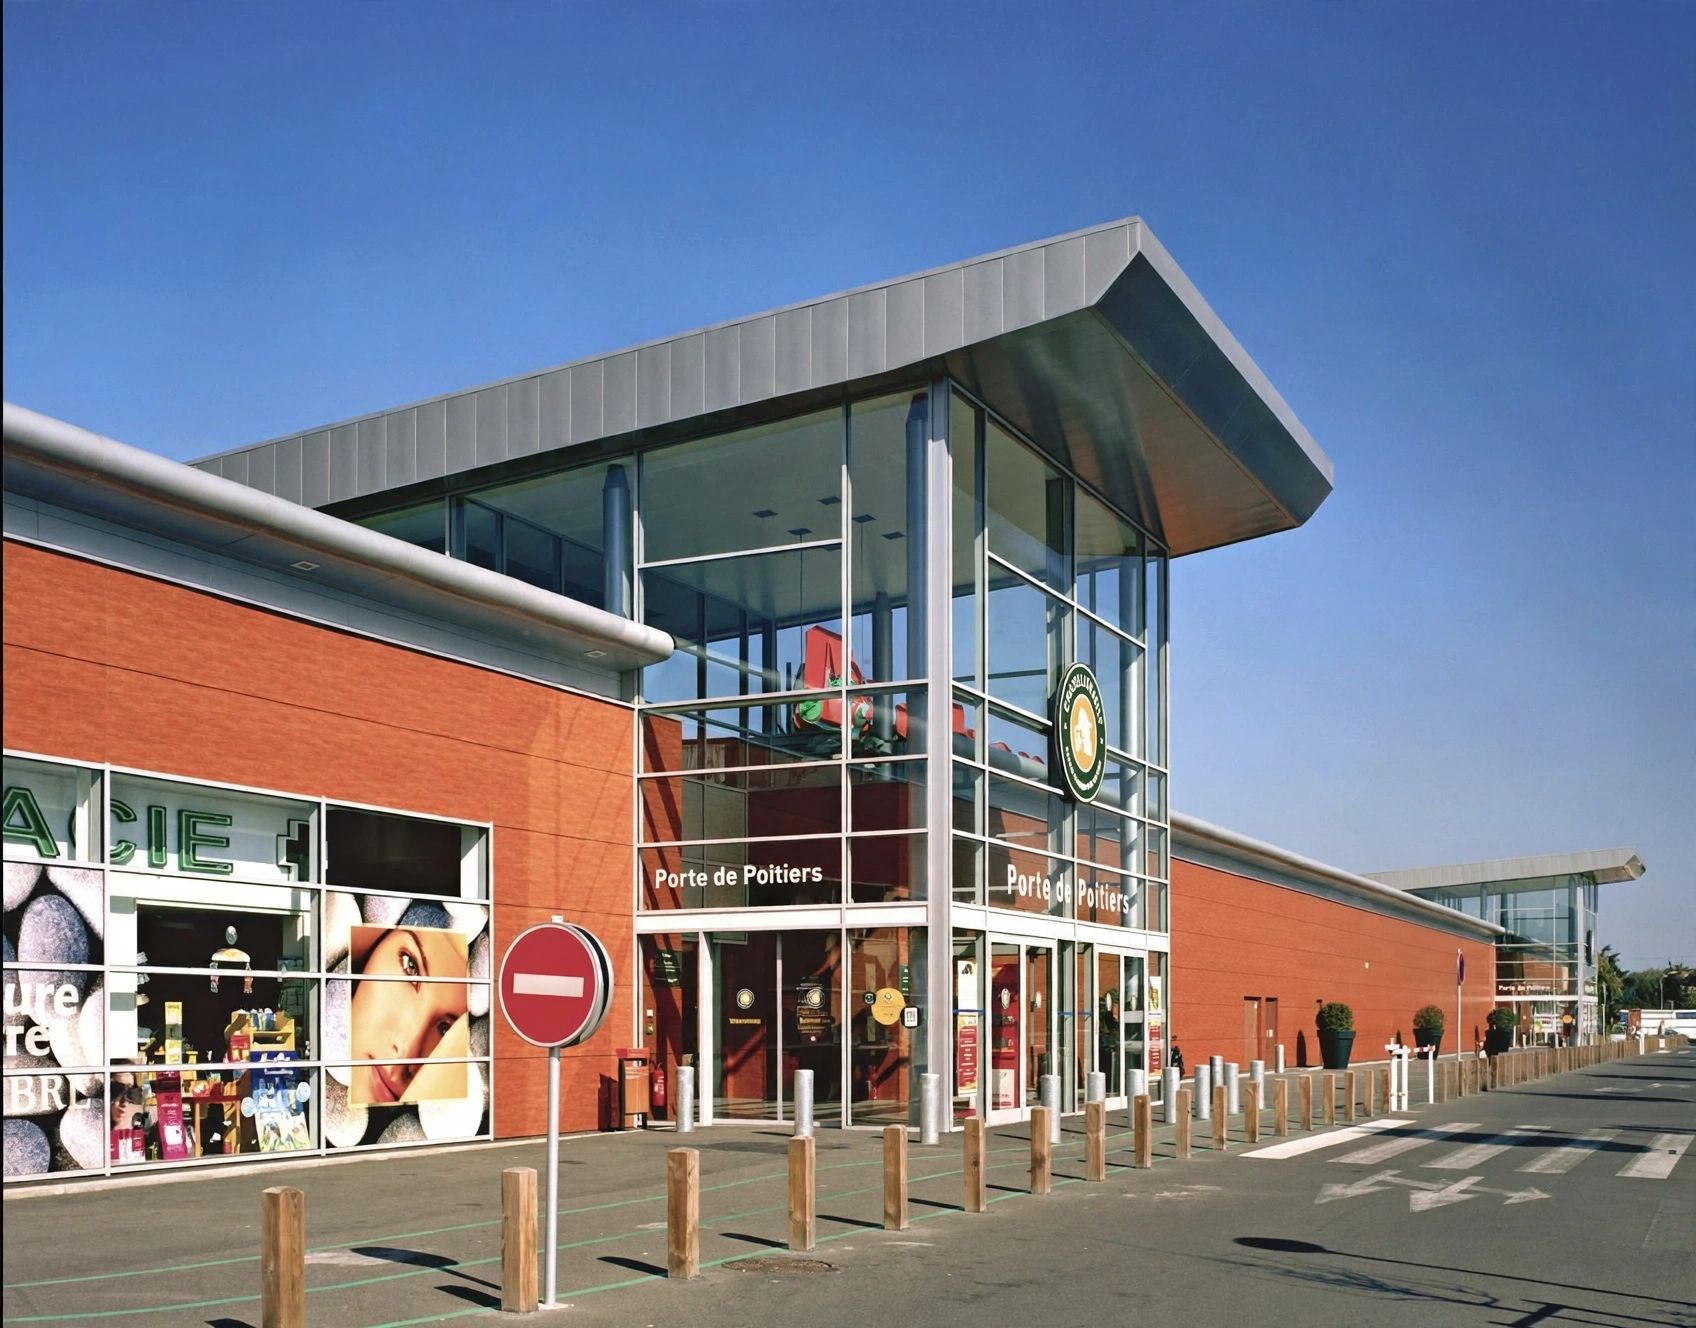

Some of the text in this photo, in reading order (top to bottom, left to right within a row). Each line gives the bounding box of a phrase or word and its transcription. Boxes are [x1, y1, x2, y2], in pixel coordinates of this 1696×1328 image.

[655, 863, 824, 889] Porte de Poitiers
[1007, 863, 1130, 914] Porte de Poitiers
[3, 1025, 51, 1058] re
